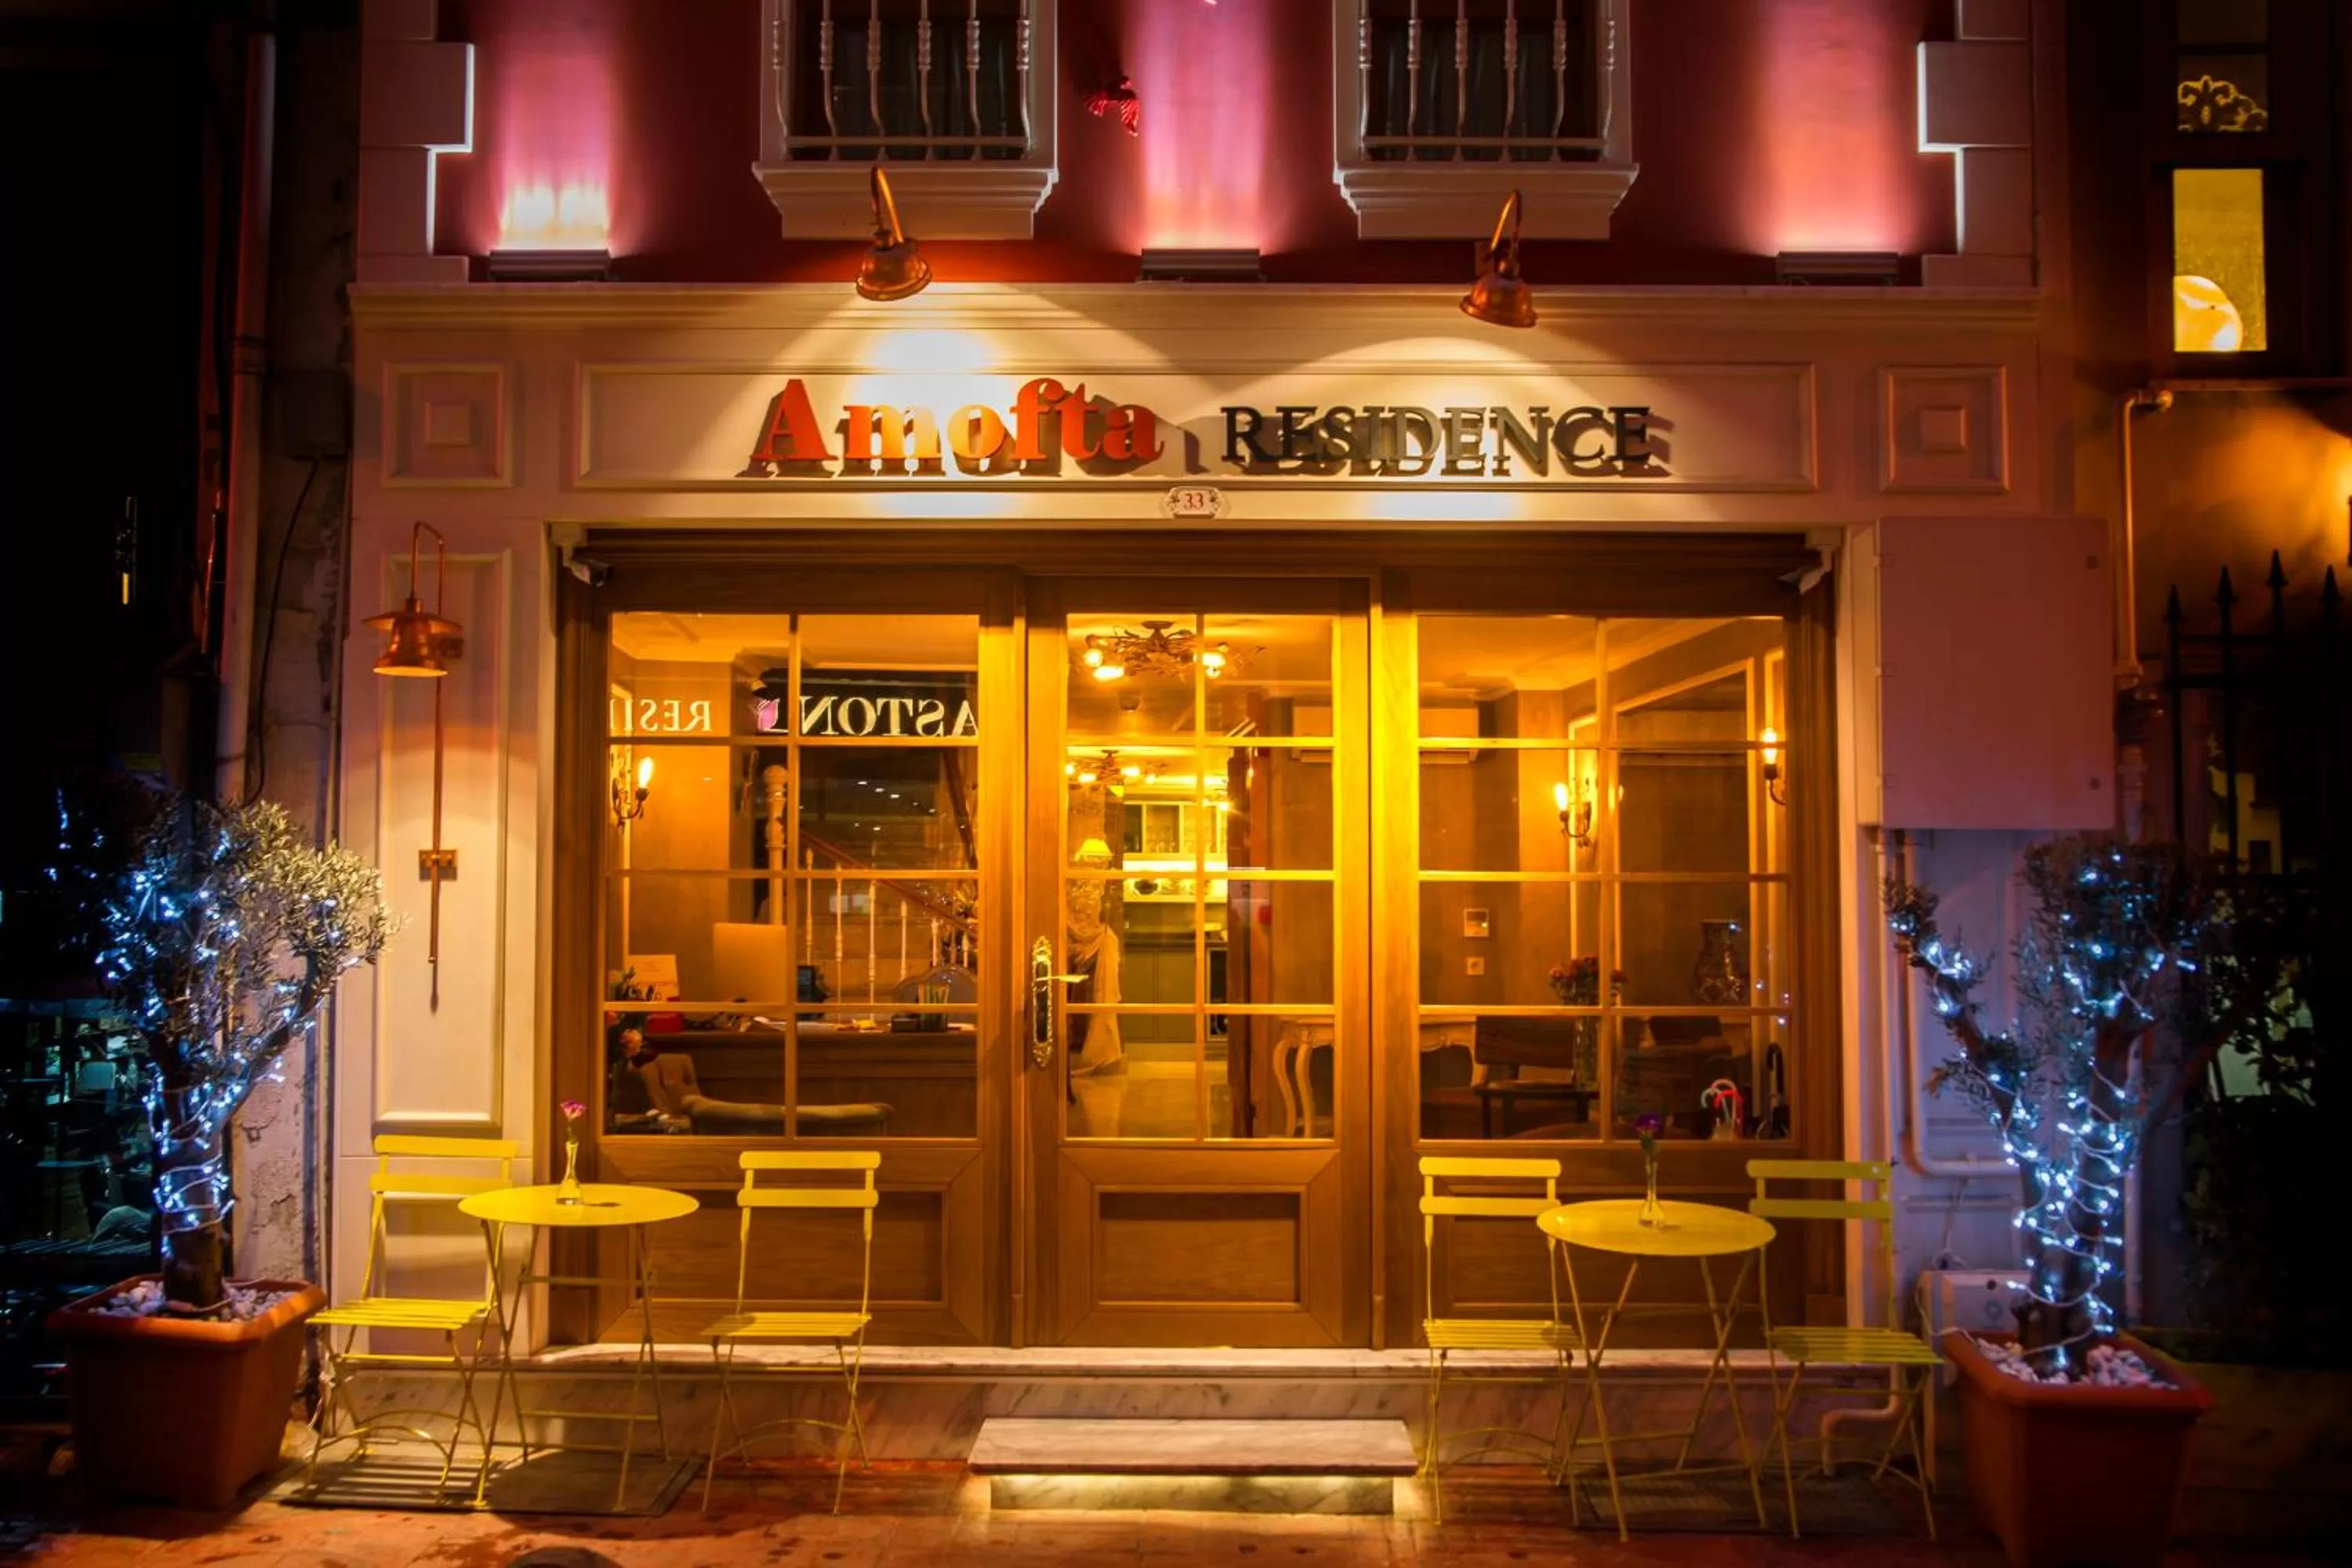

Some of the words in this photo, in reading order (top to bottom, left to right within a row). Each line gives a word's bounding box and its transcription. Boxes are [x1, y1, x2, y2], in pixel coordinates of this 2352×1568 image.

[750, 378, 1165, 462] Amofta
[1220, 405, 1651, 464] RESIDENCE
[1184, 492, 1204, 510] 33
